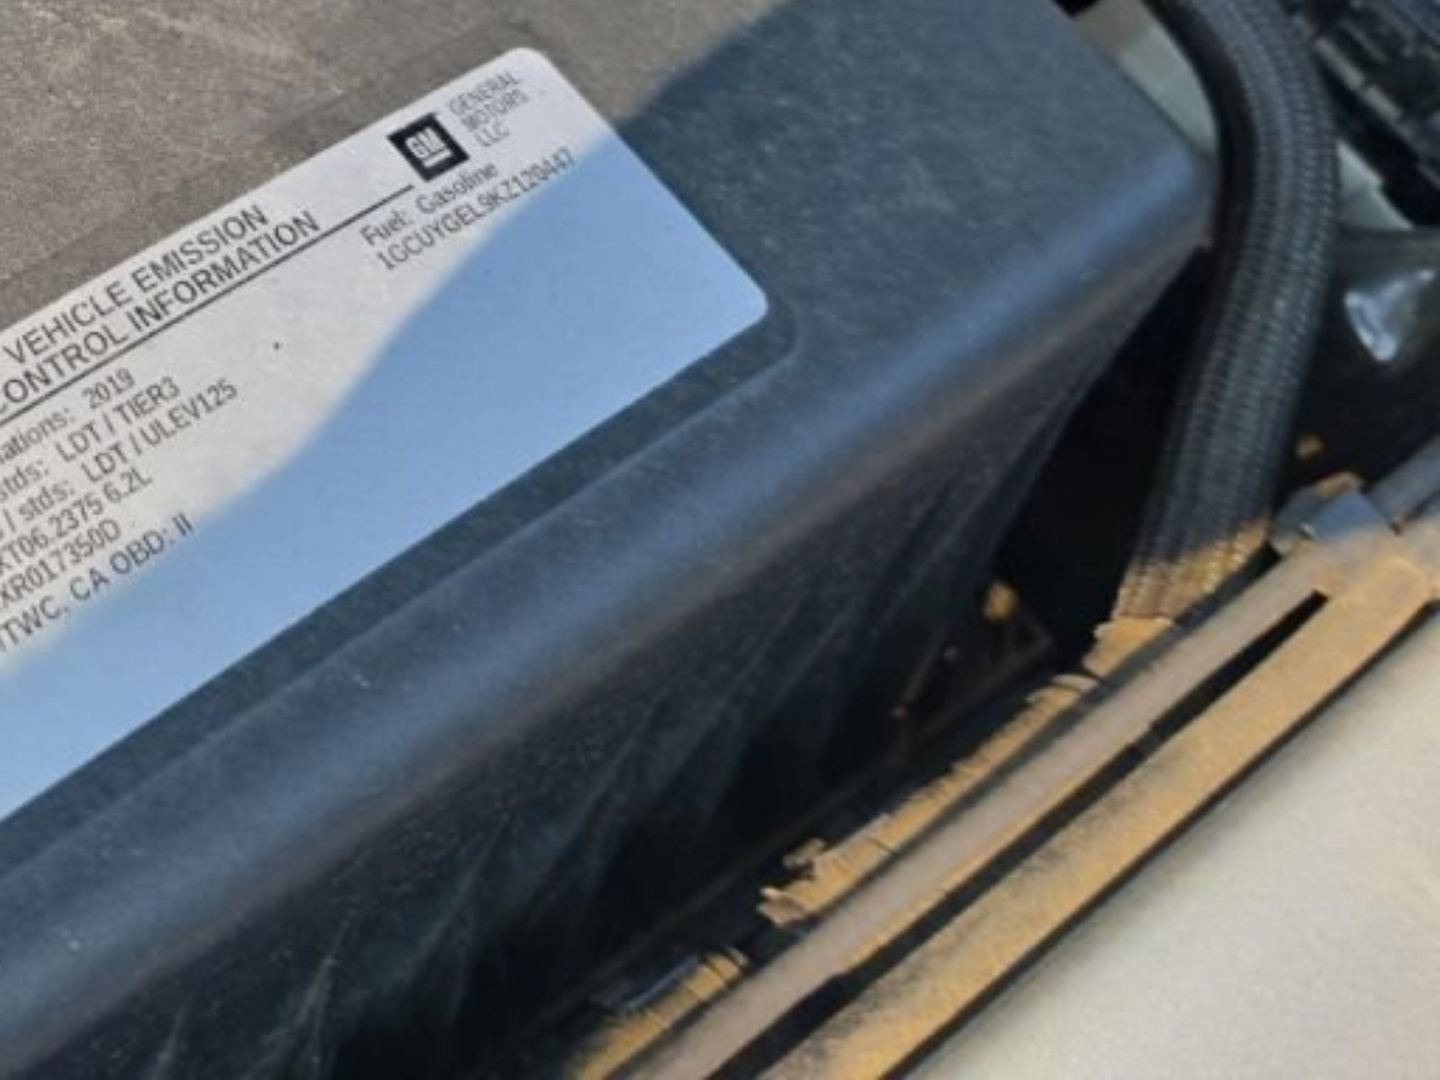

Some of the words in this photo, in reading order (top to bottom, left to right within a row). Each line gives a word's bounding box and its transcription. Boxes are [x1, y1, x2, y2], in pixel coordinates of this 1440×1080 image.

[449, 73, 521, 117] GENERAL
[460, 88, 528, 133] MOTORS
[405, 125, 447, 159] GM
[474, 120, 510, 147] LLC
[359, 209, 413, 247] Fuel:
[414, 163, 499, 215] Gasoline
[2, 280, 133, 365] VEHICLE
[130, 204, 269, 294] EMISSION
[125, 210, 321, 333] INFORMATION
[54, 419, 103, 463] LDT
[113, 377, 181, 425] TIER3
[81, 367, 136, 411] 2019
[18, 479, 75, 522] stds:
[80, 440, 129, 484] LDT
[138, 378, 238, 448] ULEV125
[102, 465, 153, 504] 6.2L
[69, 567, 109, 601] CA
[109, 528, 175, 575] OBD:
[171, 511, 193, 537] II
